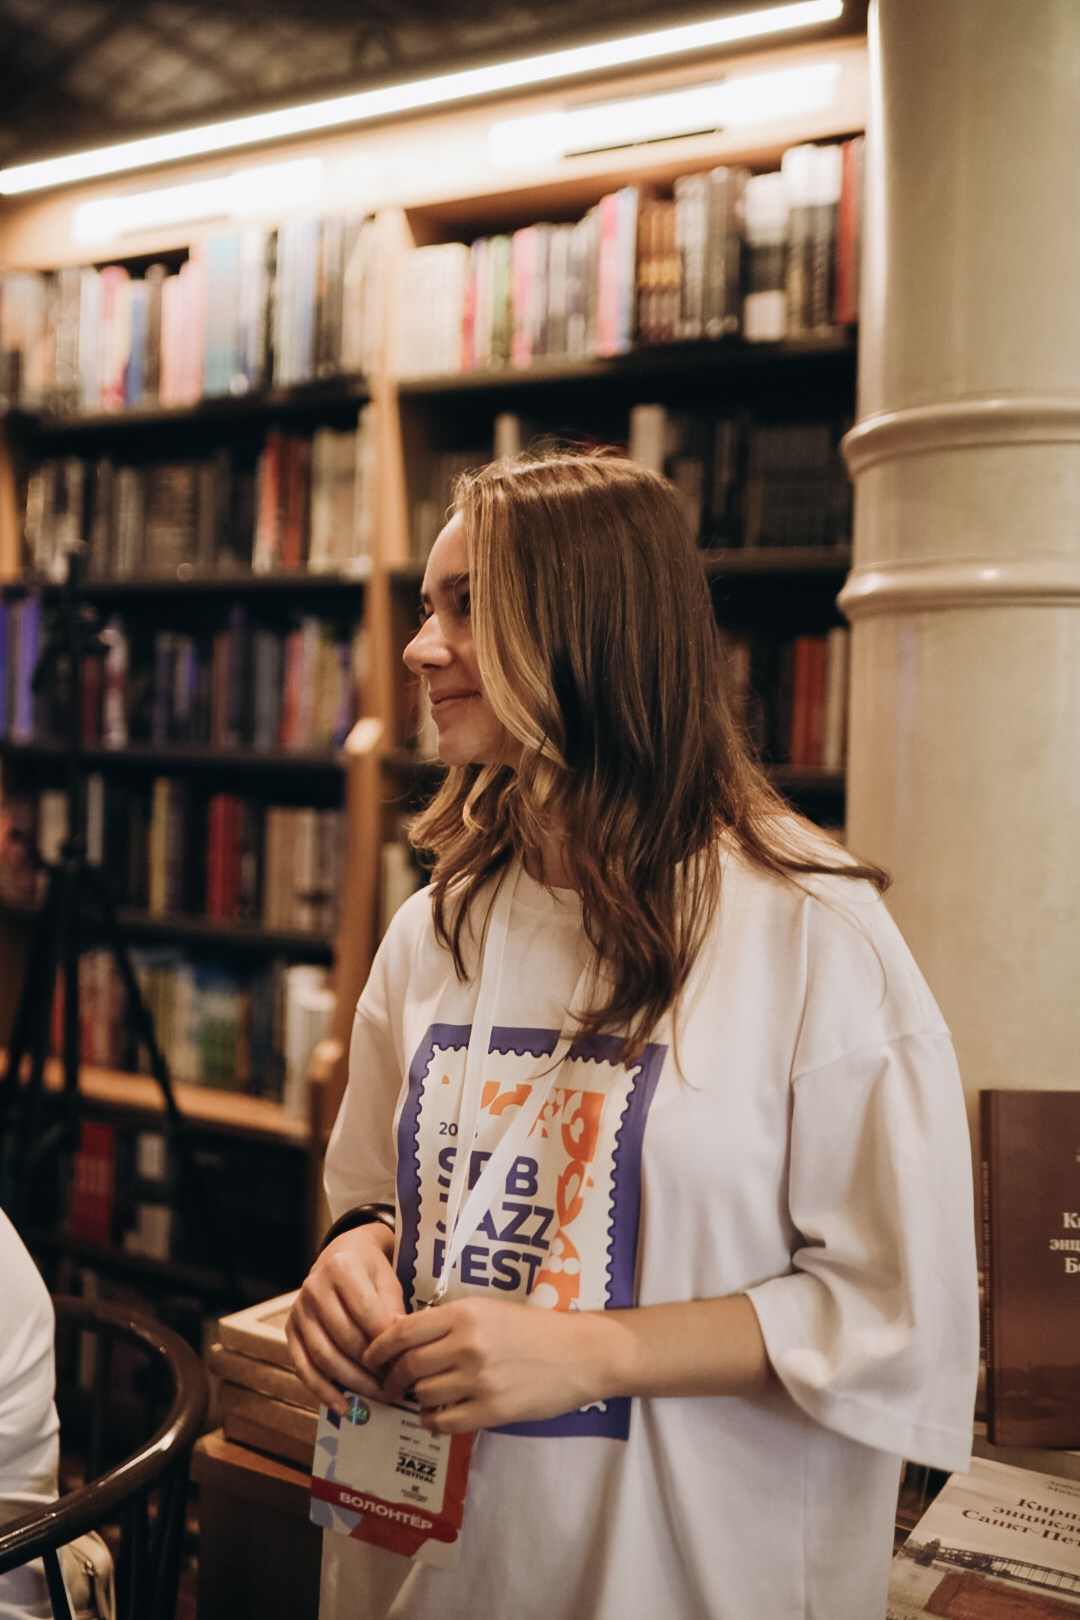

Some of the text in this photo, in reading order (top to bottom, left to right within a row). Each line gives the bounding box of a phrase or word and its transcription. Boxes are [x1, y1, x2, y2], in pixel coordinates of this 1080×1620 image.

[397, 1455, 437, 1477] JAZZ
[338, 1491, 433, 1530] ВОЛОНТЁР
[1017, 1498, 1080, 1521] Кирп
